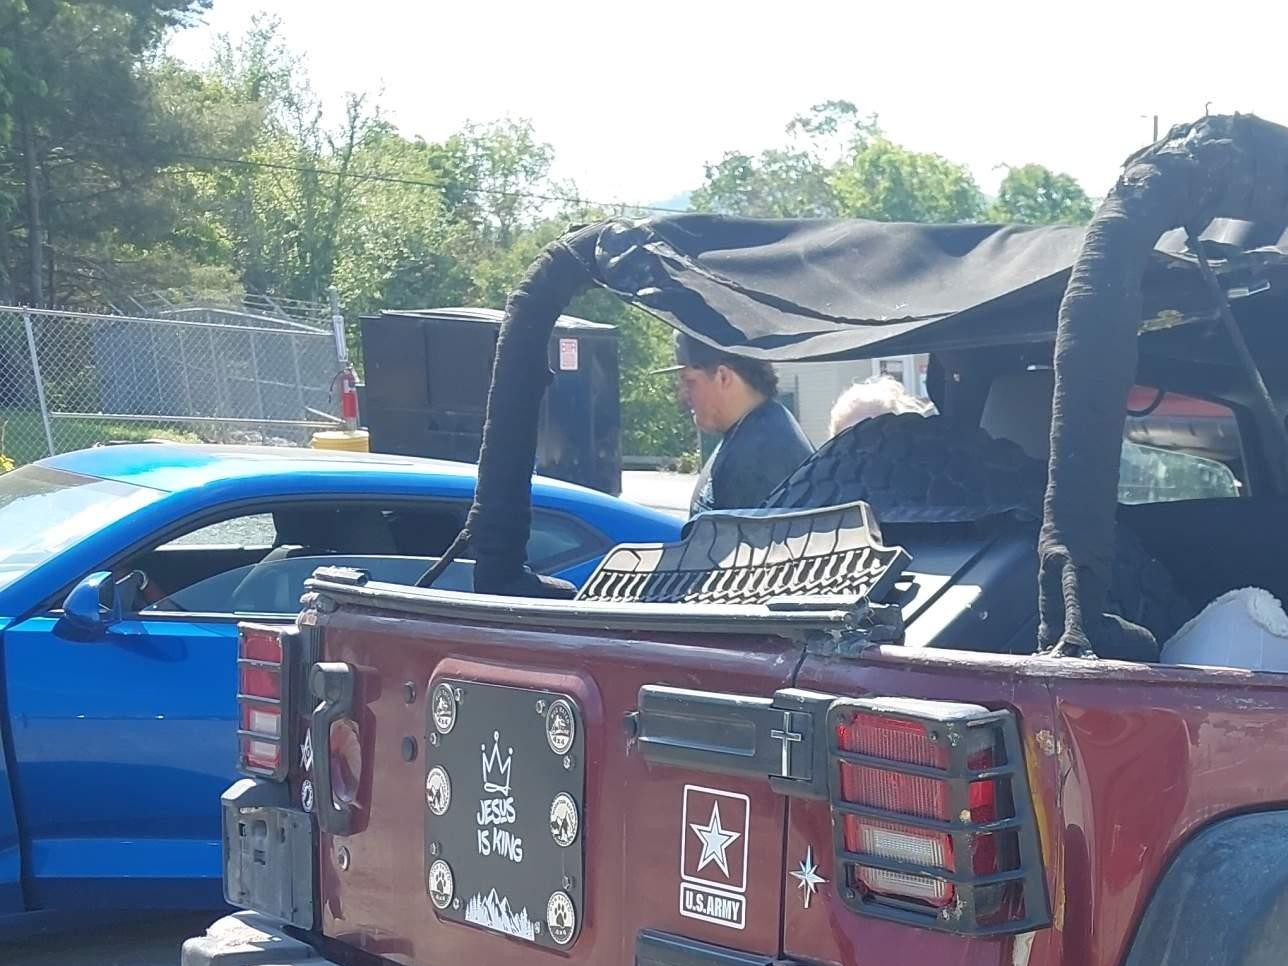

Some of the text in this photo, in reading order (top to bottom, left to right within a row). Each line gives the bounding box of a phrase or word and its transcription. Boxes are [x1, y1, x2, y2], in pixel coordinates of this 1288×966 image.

[477, 797, 516, 825] JESUS
[478, 827, 523, 863] IS KING
